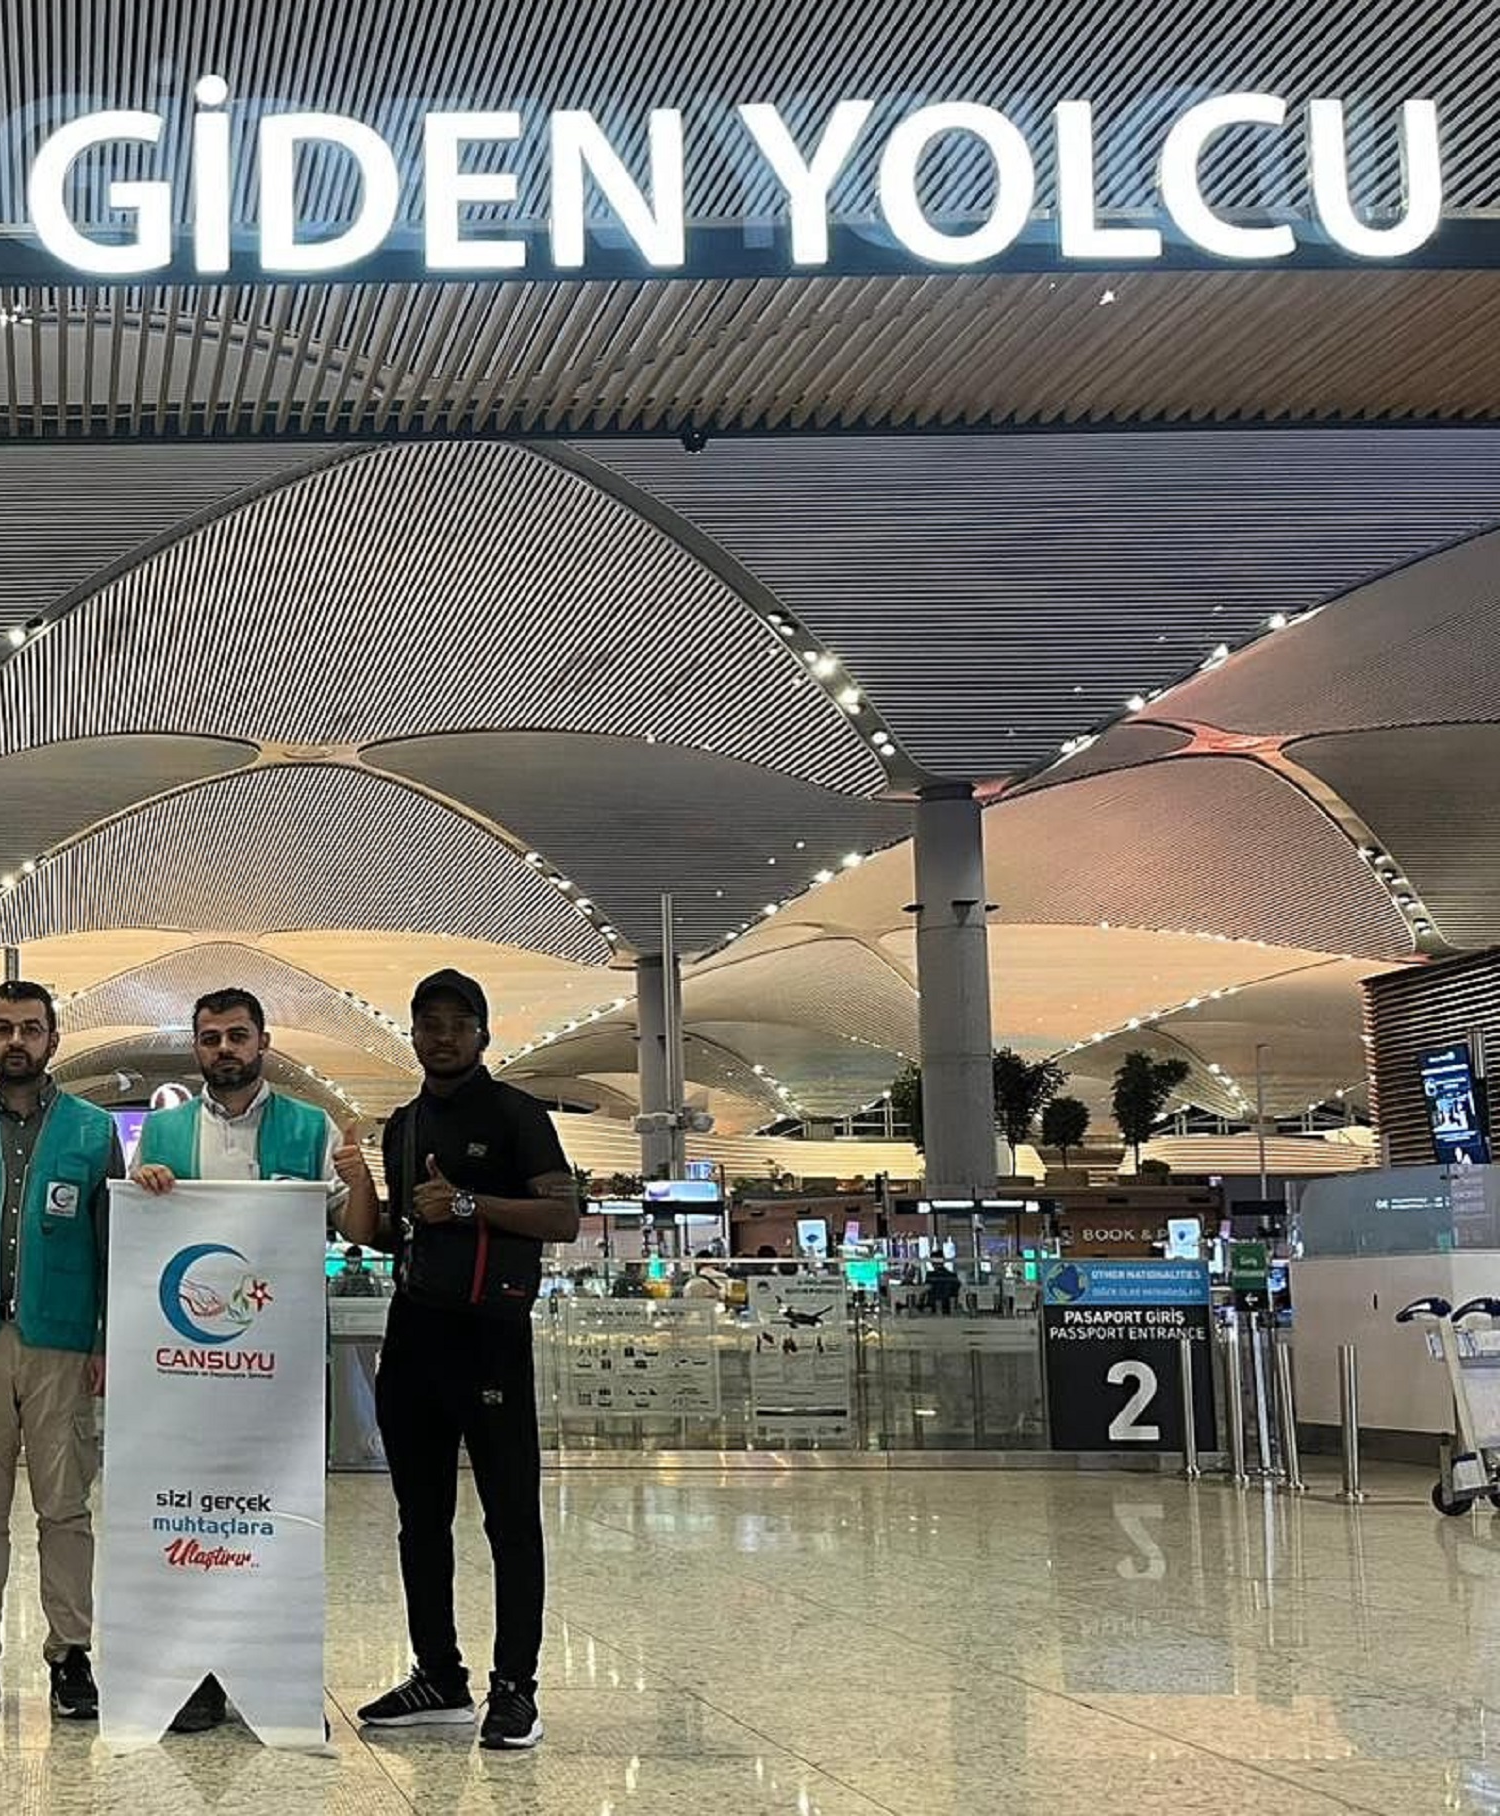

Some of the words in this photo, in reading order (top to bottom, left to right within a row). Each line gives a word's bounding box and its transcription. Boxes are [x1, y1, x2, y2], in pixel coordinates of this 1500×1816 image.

[27, 73, 686, 275] GİDEN
[736, 91, 1444, 265] YOLCU
[1082, 1228, 1135, 1242] BOOK
[1063, 1310, 1142, 1325] PASAPORT
[1145, 1307, 1185, 1326] GİRİŞ
[1049, 1326, 1125, 1340] PASSPORT
[1129, 1326, 1207, 1340] ENTRANCE
[156, 1347, 275, 1371] CANSUYU
[1106, 1360, 1160, 1442] 2
[156, 1489, 192, 1509] sizi
[201, 1493, 271, 1514] gerçek
[152, 1516, 274, 1539] muhtaçlara
